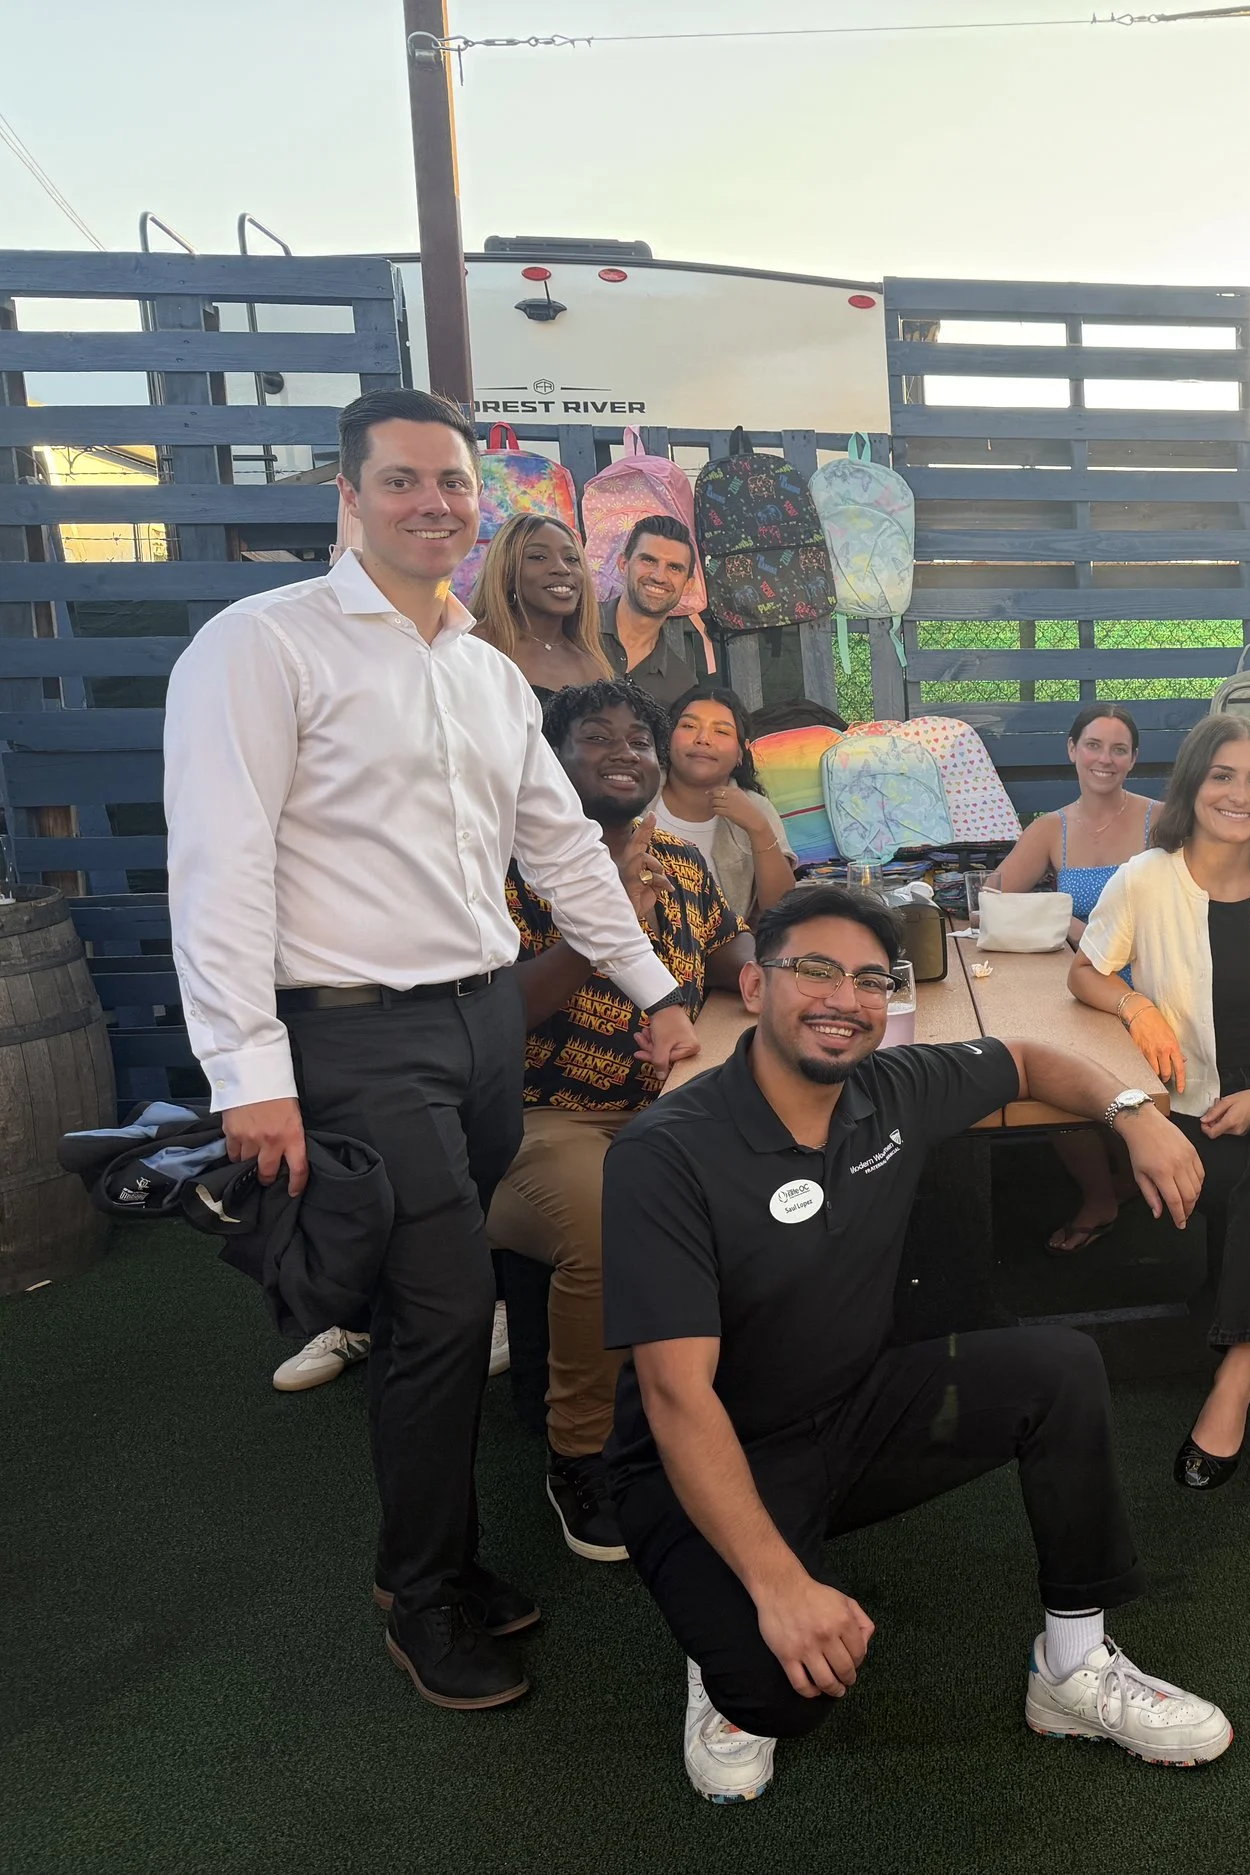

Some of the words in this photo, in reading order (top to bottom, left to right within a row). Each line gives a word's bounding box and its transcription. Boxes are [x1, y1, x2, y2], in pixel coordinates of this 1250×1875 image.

[562, 401, 646, 413] RIVER
[567, 1009, 616, 1036] THINGS
[554, 1048, 630, 1086] STRANGER
[561, 1064, 611, 1091] THINGS
[850, 1158, 875, 1174] Modern
[785, 1203, 797, 1214] Saul
[797, 1199, 813, 1209] Lopez
